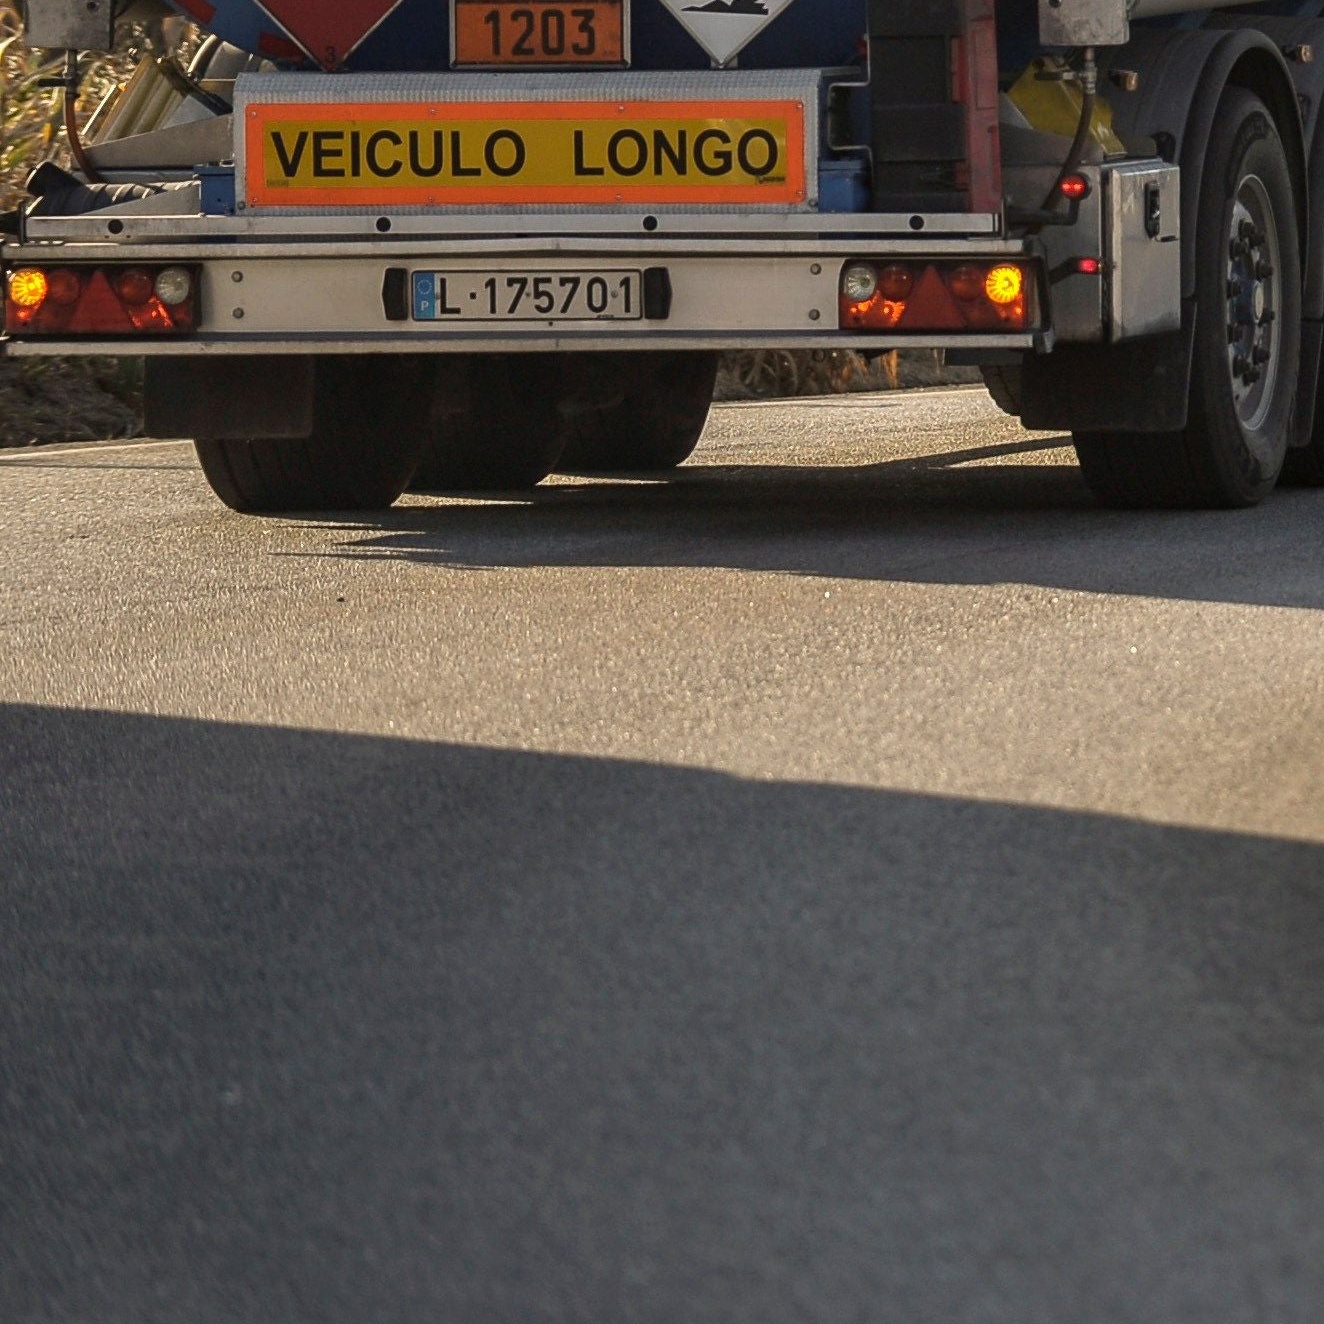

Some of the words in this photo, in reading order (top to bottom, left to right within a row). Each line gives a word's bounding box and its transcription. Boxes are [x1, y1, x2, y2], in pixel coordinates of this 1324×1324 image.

[484, 9, 597, 56] 1203
[271, 129, 527, 178] VEICULO
[574, 127, 779, 177] LONGO
[421, 300, 429, 311] P
